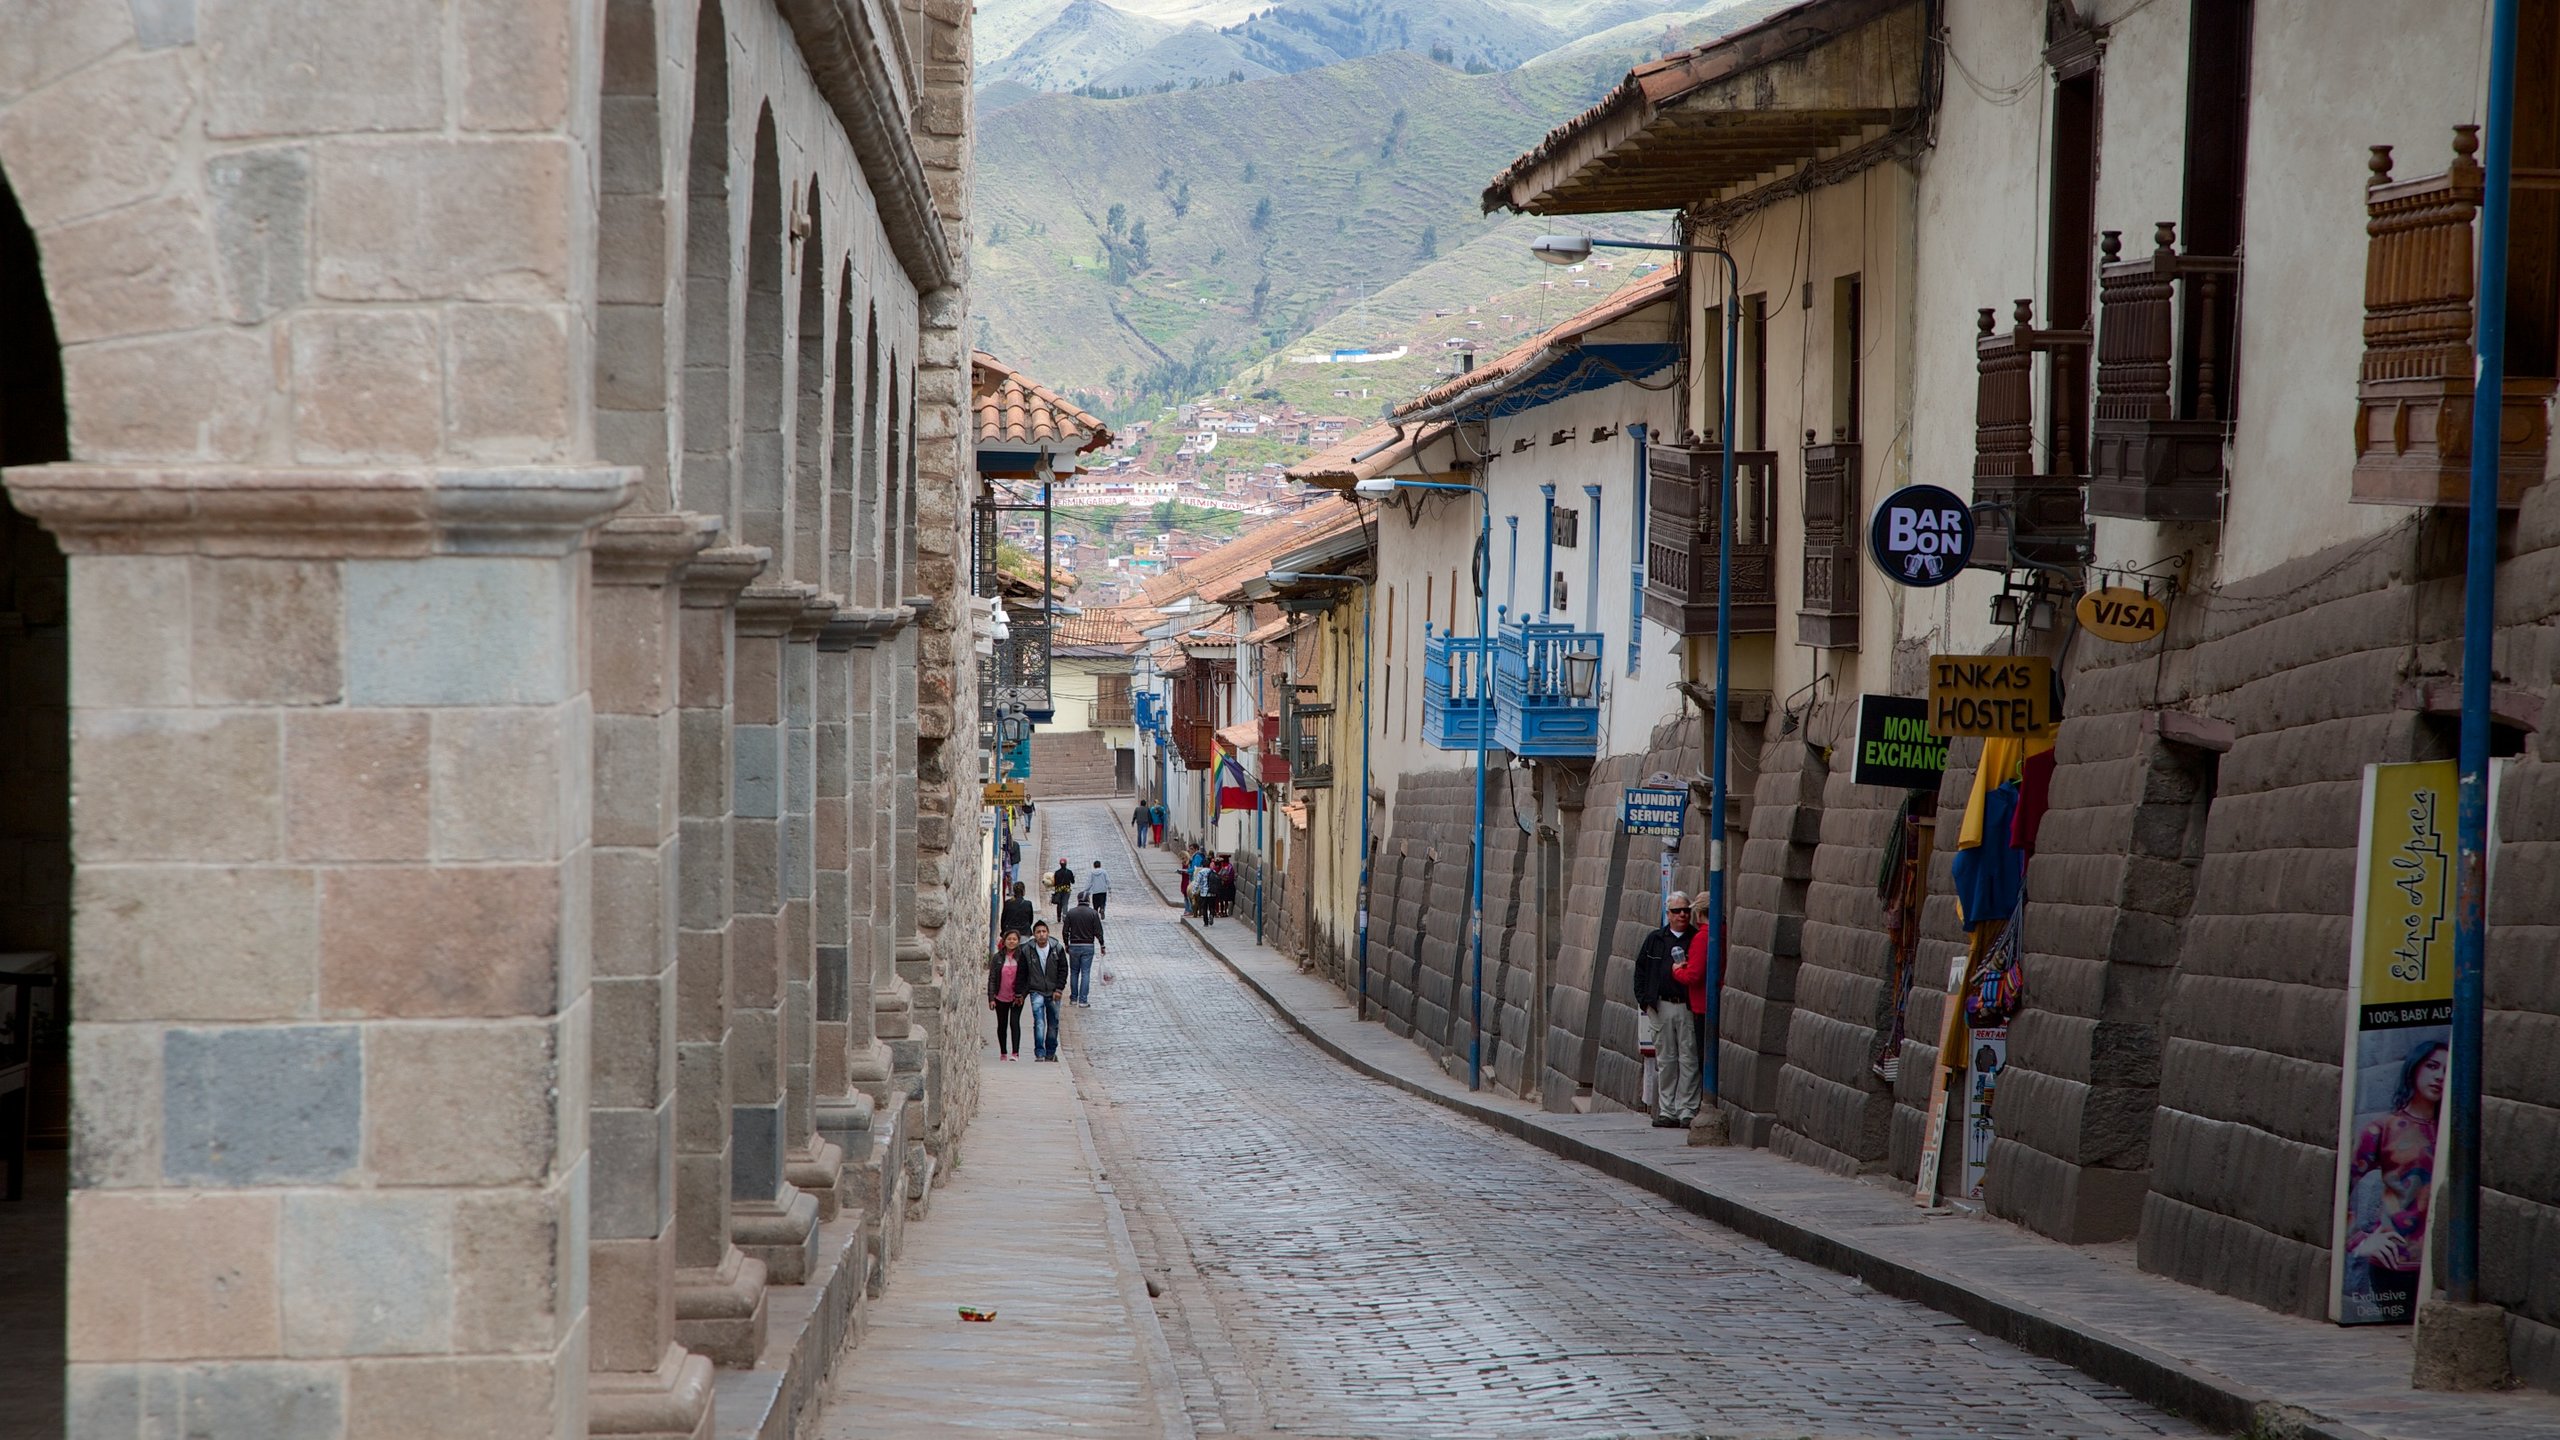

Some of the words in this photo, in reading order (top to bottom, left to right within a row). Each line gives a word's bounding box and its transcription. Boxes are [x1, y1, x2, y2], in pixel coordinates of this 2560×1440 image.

[2090, 599, 2155, 631] VISA
[1938, 663, 2031, 689] INKA'S
[1938, 696, 2042, 732] HOSTEL
[1628, 793, 1682, 807] LAUNDRY
[1629, 809, 1680, 823] SERVICE
[1628, 825, 1637, 834] IN
[1639, 826, 1646, 834] 2
[1647, 826, 1680, 836] HOURS
[2392, 790, 2438, 906] Alpaca
[2392, 914, 2424, 982] Etro
[2368, 1010, 2399, 1024] 100%
[2401, 1008, 2429, 1022] BABY
[2432, 1007, 2452, 1019] ALP
[2352, 1290, 2407, 1303] Exclusive
